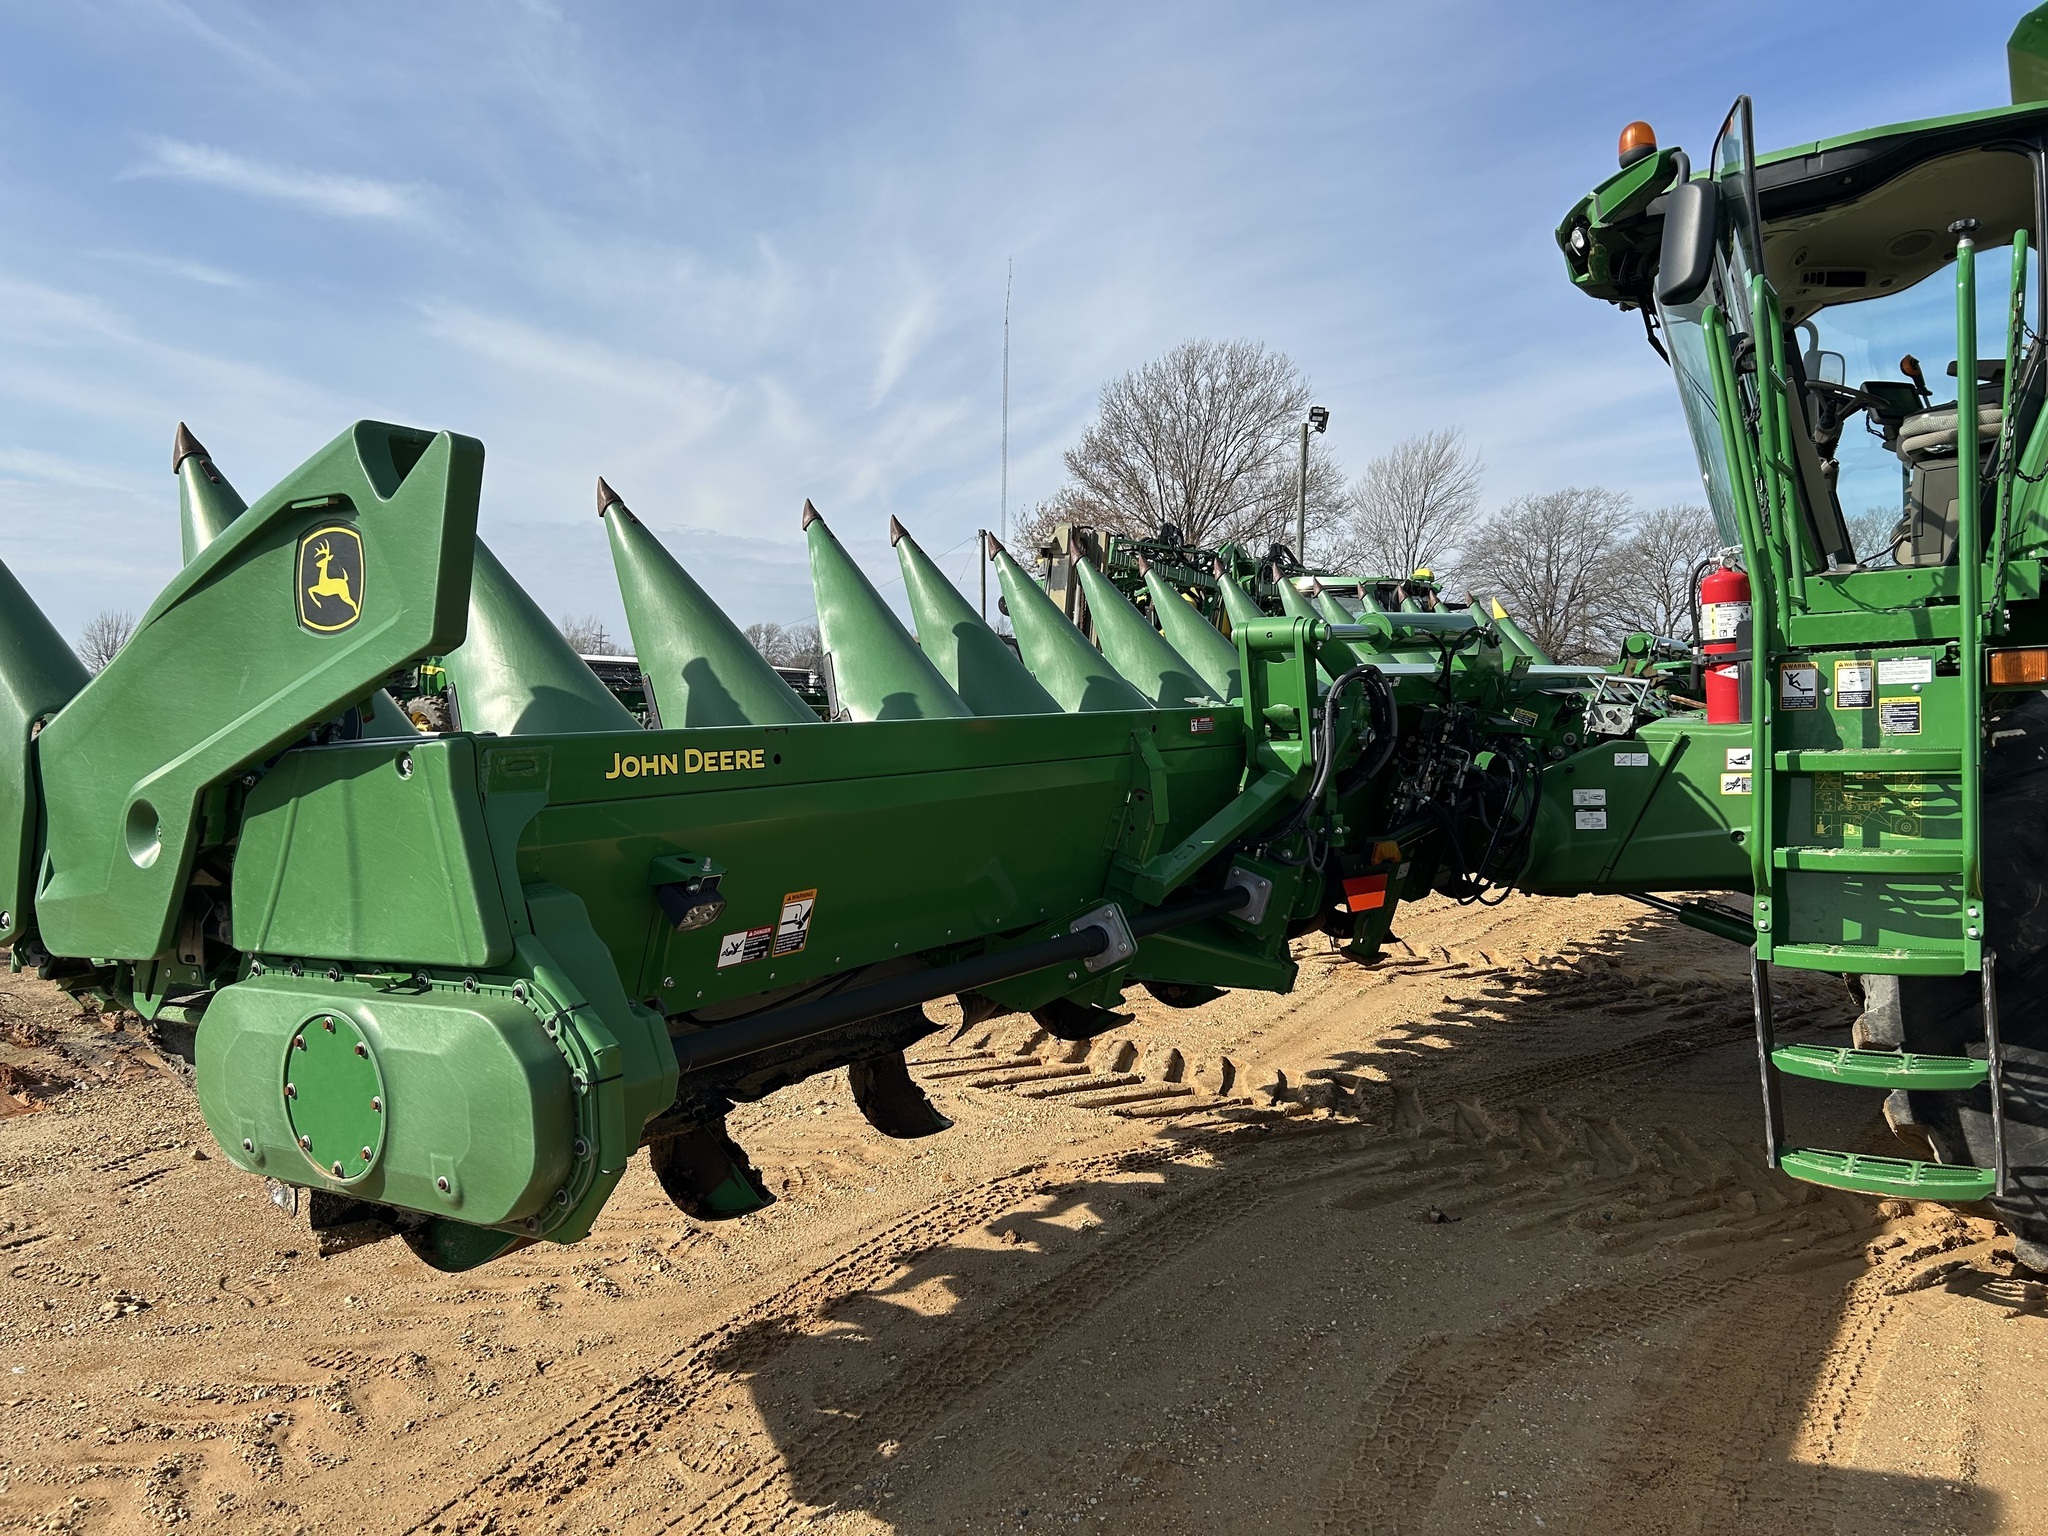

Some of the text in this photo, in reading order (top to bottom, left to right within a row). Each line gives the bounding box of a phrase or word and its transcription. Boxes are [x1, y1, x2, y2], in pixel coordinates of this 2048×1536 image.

[605, 748, 766, 780] JOHN DEERE
[792, 892, 813, 900] WARNING
